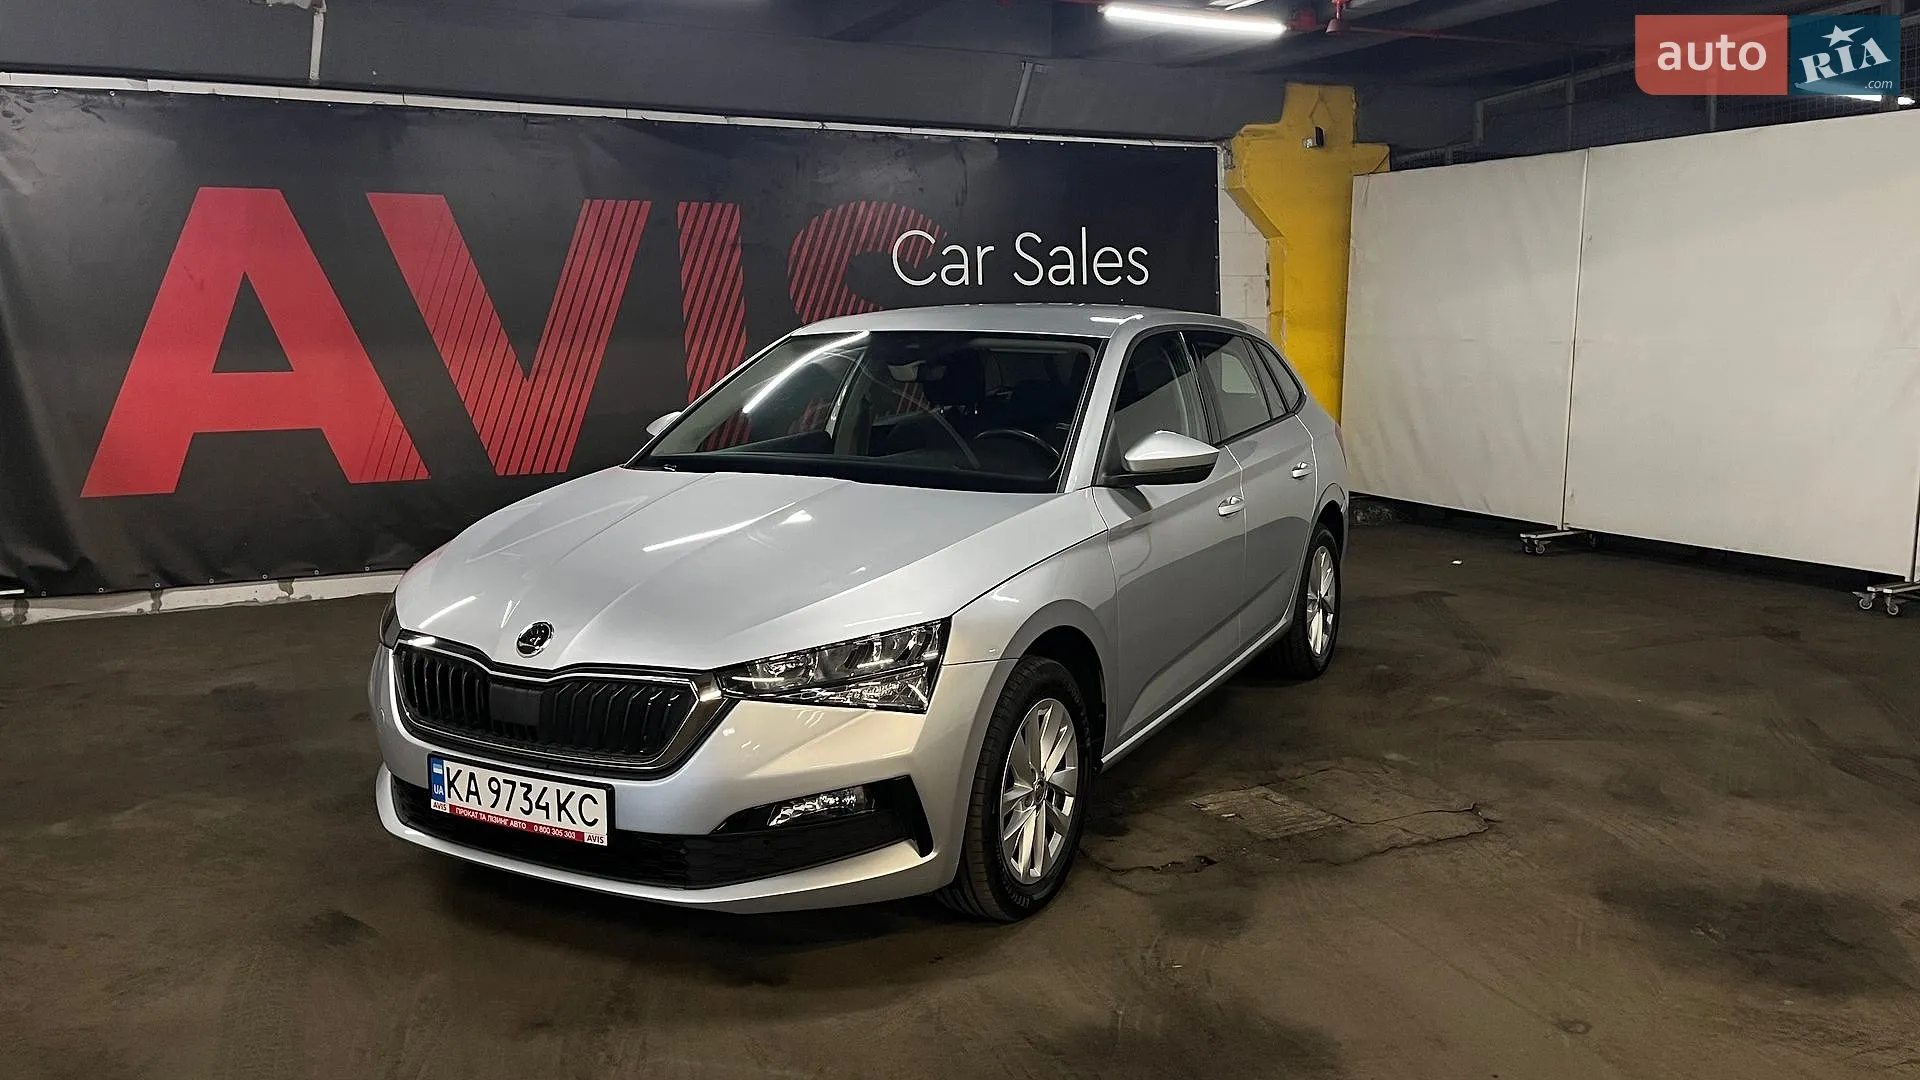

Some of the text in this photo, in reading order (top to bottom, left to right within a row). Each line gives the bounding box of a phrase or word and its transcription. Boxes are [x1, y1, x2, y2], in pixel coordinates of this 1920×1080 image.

[892, 227, 1150, 286] Car Sales
[434, 784, 444, 796] UA
[433, 801, 447, 811] AVIS
[586, 834, 604, 844] AVIS
